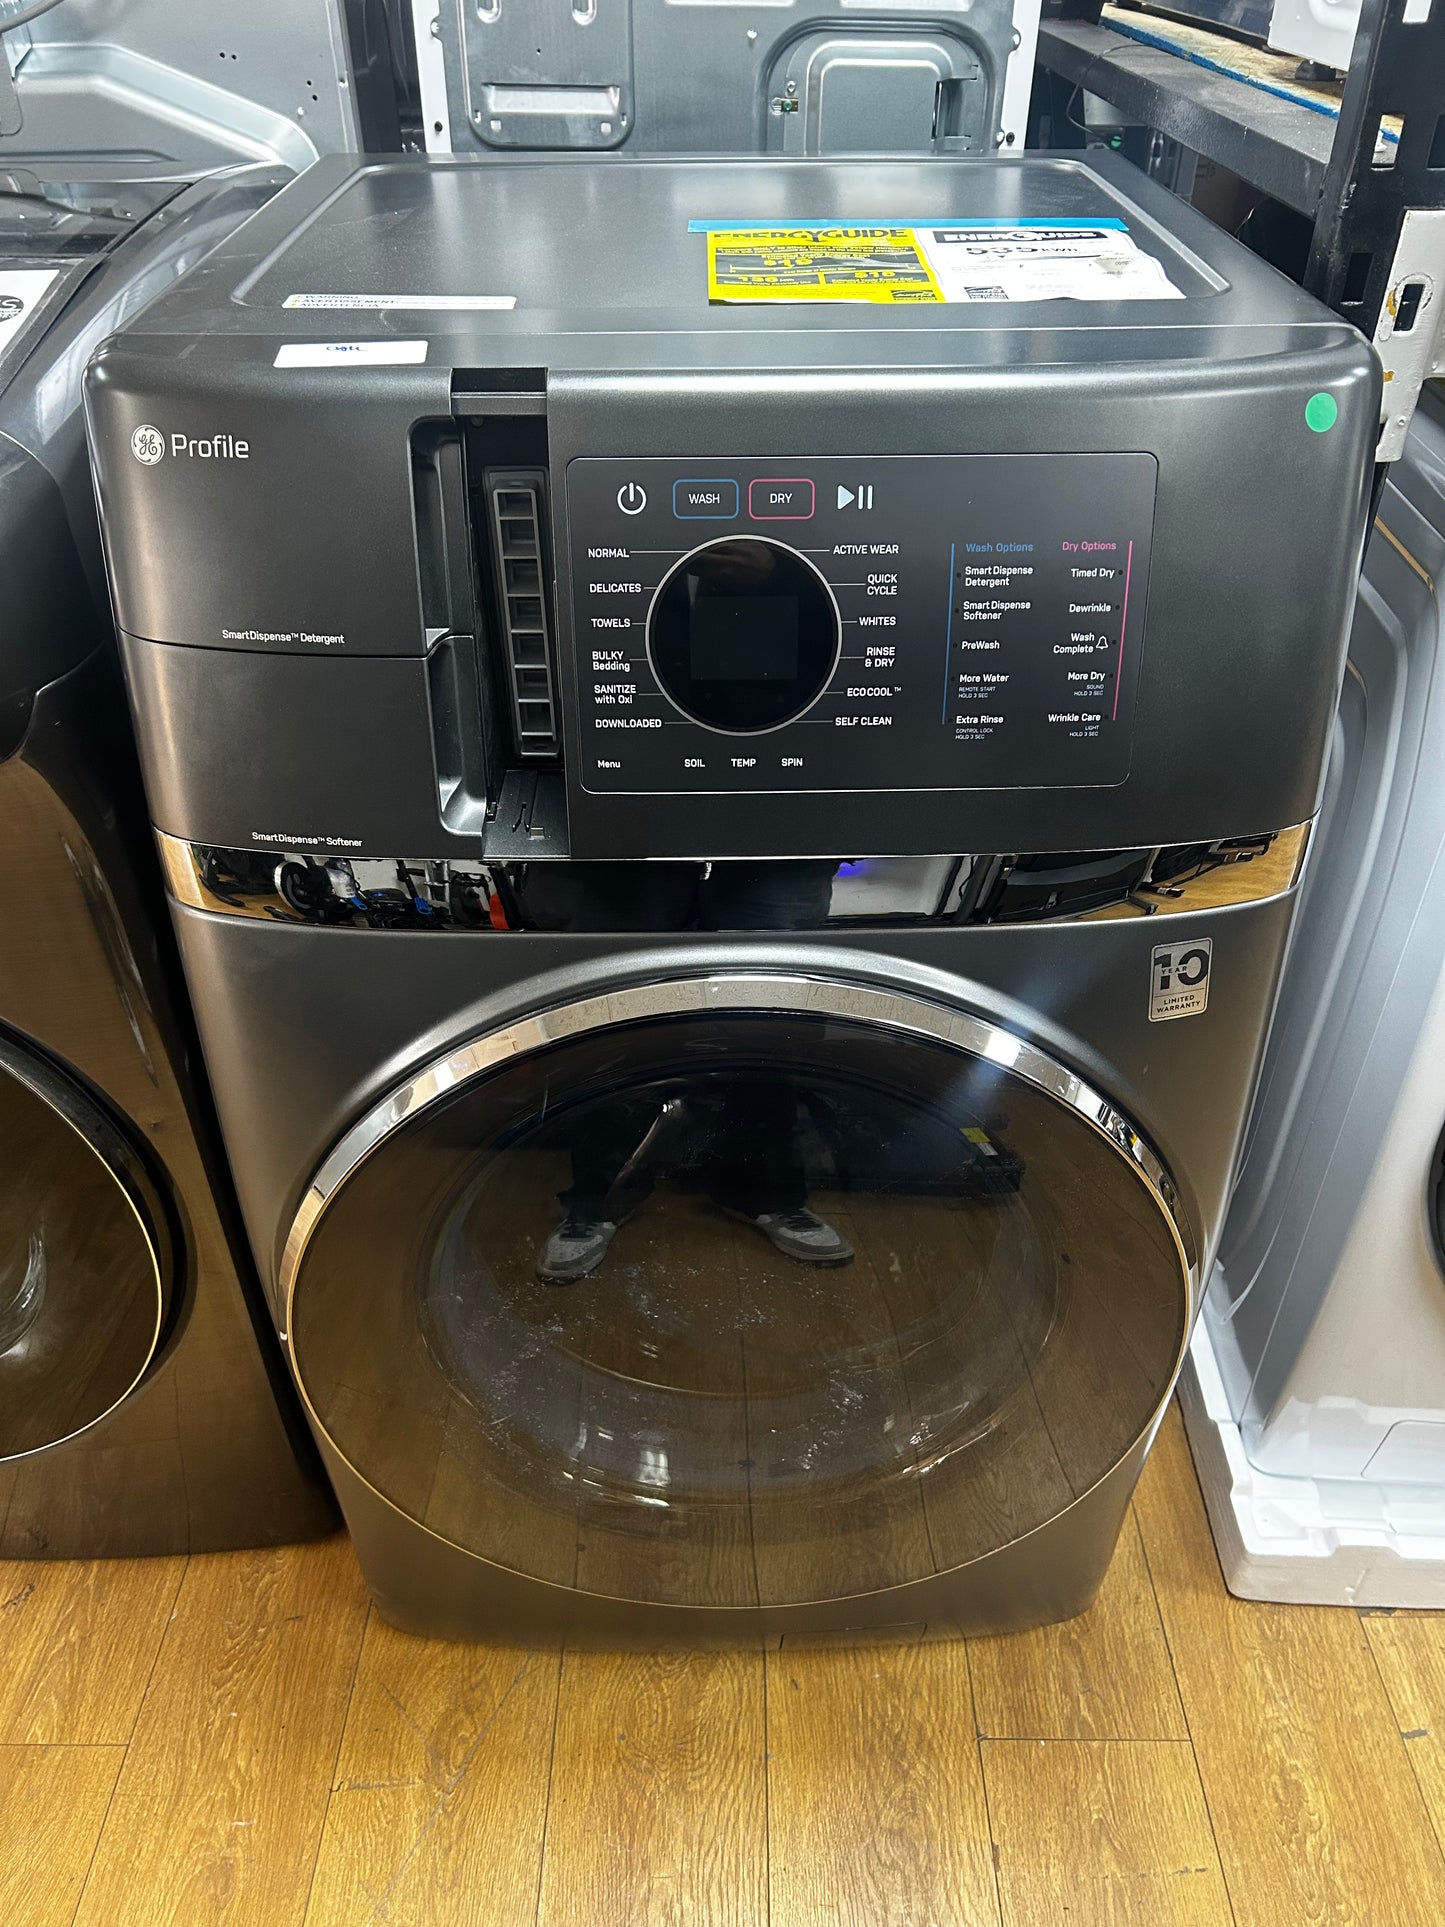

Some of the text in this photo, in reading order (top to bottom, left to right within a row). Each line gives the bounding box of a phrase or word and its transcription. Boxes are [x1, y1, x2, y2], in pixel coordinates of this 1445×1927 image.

[714, 229, 908, 242] ENERGYGUIDE
[966, 247, 1038, 255] 535
[171, 433, 249, 458] Profile
[689, 494, 719, 504] WASH
[770, 493, 792, 503] DRY
[833, 545, 899, 554] ACTIVE WEAR
[966, 543, 1033, 553] Wash Options
[1063, 541, 1116, 552] Dry Options
[588, 548, 629, 558] NORMAL
[1071, 568, 1114, 579] Timed Dry
[867, 573, 898, 584] QUICK
[965, 577, 1010, 588] Detergent
[590, 583, 641, 592] DELICATES
[867, 586, 897, 596] CYCLE
[1069, 603, 1111, 612] Dewrinkle
[963, 611, 1002, 620] Softener
[591, 618, 630, 627] TOWELS
[859, 617, 896, 625] WHITES
[300, 633, 345, 646] Detergent
[1071, 633, 1094, 641] Wash
[962, 640, 999, 649] PreWash
[867, 647, 895, 656] RINSE
[1053, 645, 1093, 654] Complete
[592, 651, 624, 661] BULKY
[593, 661, 630, 672] Bedding
[864, 658, 894, 667] & DRY
[983, 674, 1009, 682] Water
[1068, 672, 1105, 681] More Dry
[594, 684, 636, 694] SANITIZE
[595, 694, 633, 704] with Oxi
[835, 717, 892, 726] SELF CLEAN
[956, 715, 1003, 724] Extra Rinse
[1048, 713, 1101, 722] Wrinkle Care
[596, 719, 661, 728] DOWNLOADED
[598, 760, 620, 768] Menu
[685, 759, 705, 767] SOIL
[731, 759, 756, 767] TEMP
[782, 758, 802, 766] SPIN
[326, 837, 363, 847] Softener
[1154, 949, 1209, 990] 10
[1161, 965, 1187, 975] YEAR
[1163, 994, 1195, 1005] LIMITED
[1157, 1000, 1201, 1014] WARRANTY
